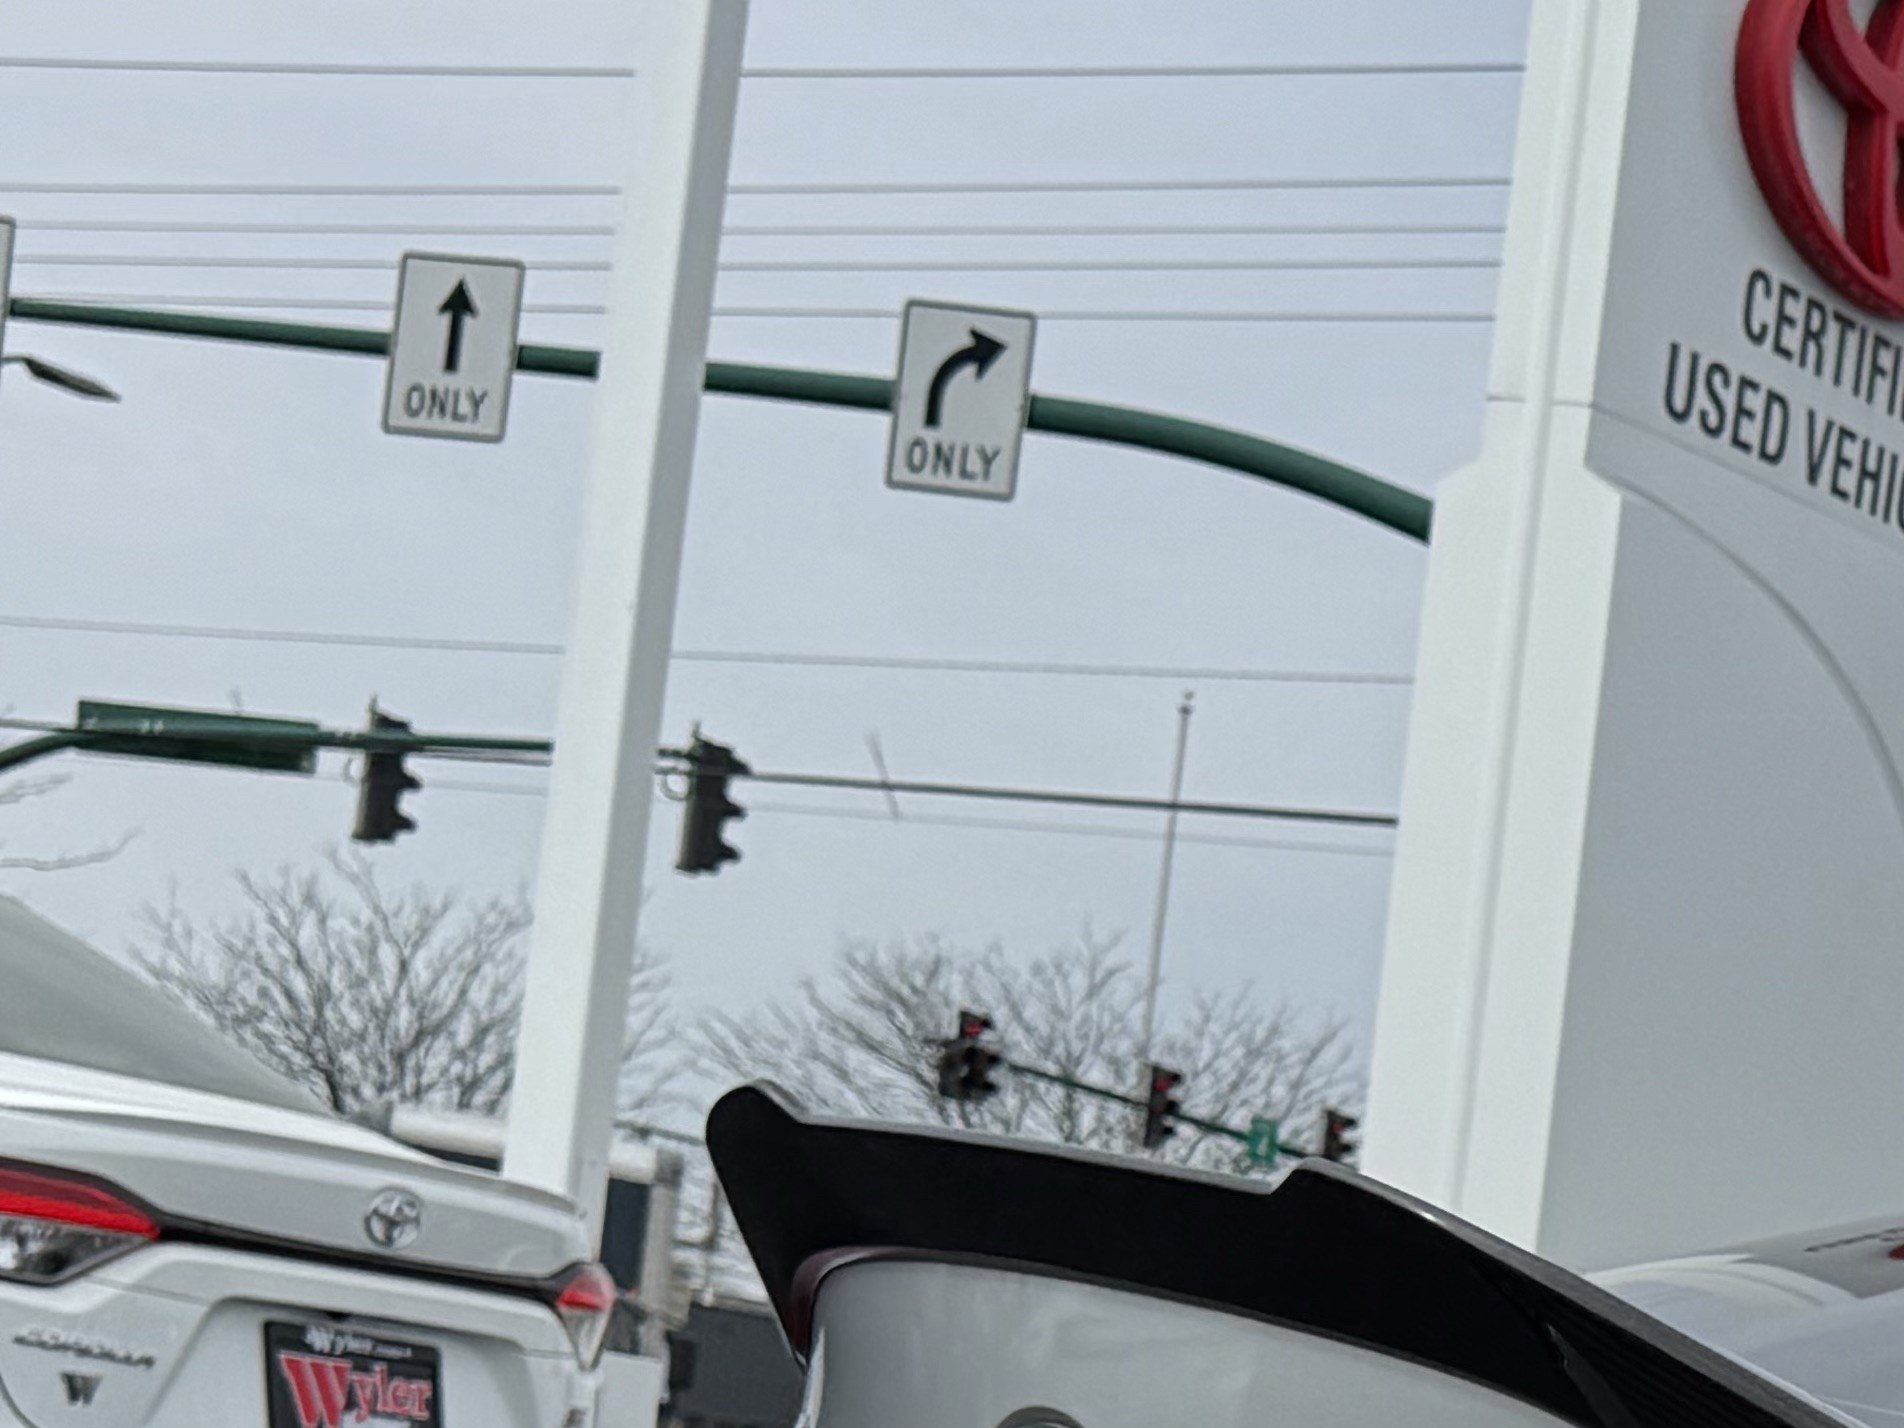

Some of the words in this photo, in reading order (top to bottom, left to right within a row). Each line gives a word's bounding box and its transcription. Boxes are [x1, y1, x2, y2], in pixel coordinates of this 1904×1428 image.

[402, 382, 489, 424] ONLY
[1662, 341, 1790, 467] USED
[904, 436, 1001, 482] ONLY
